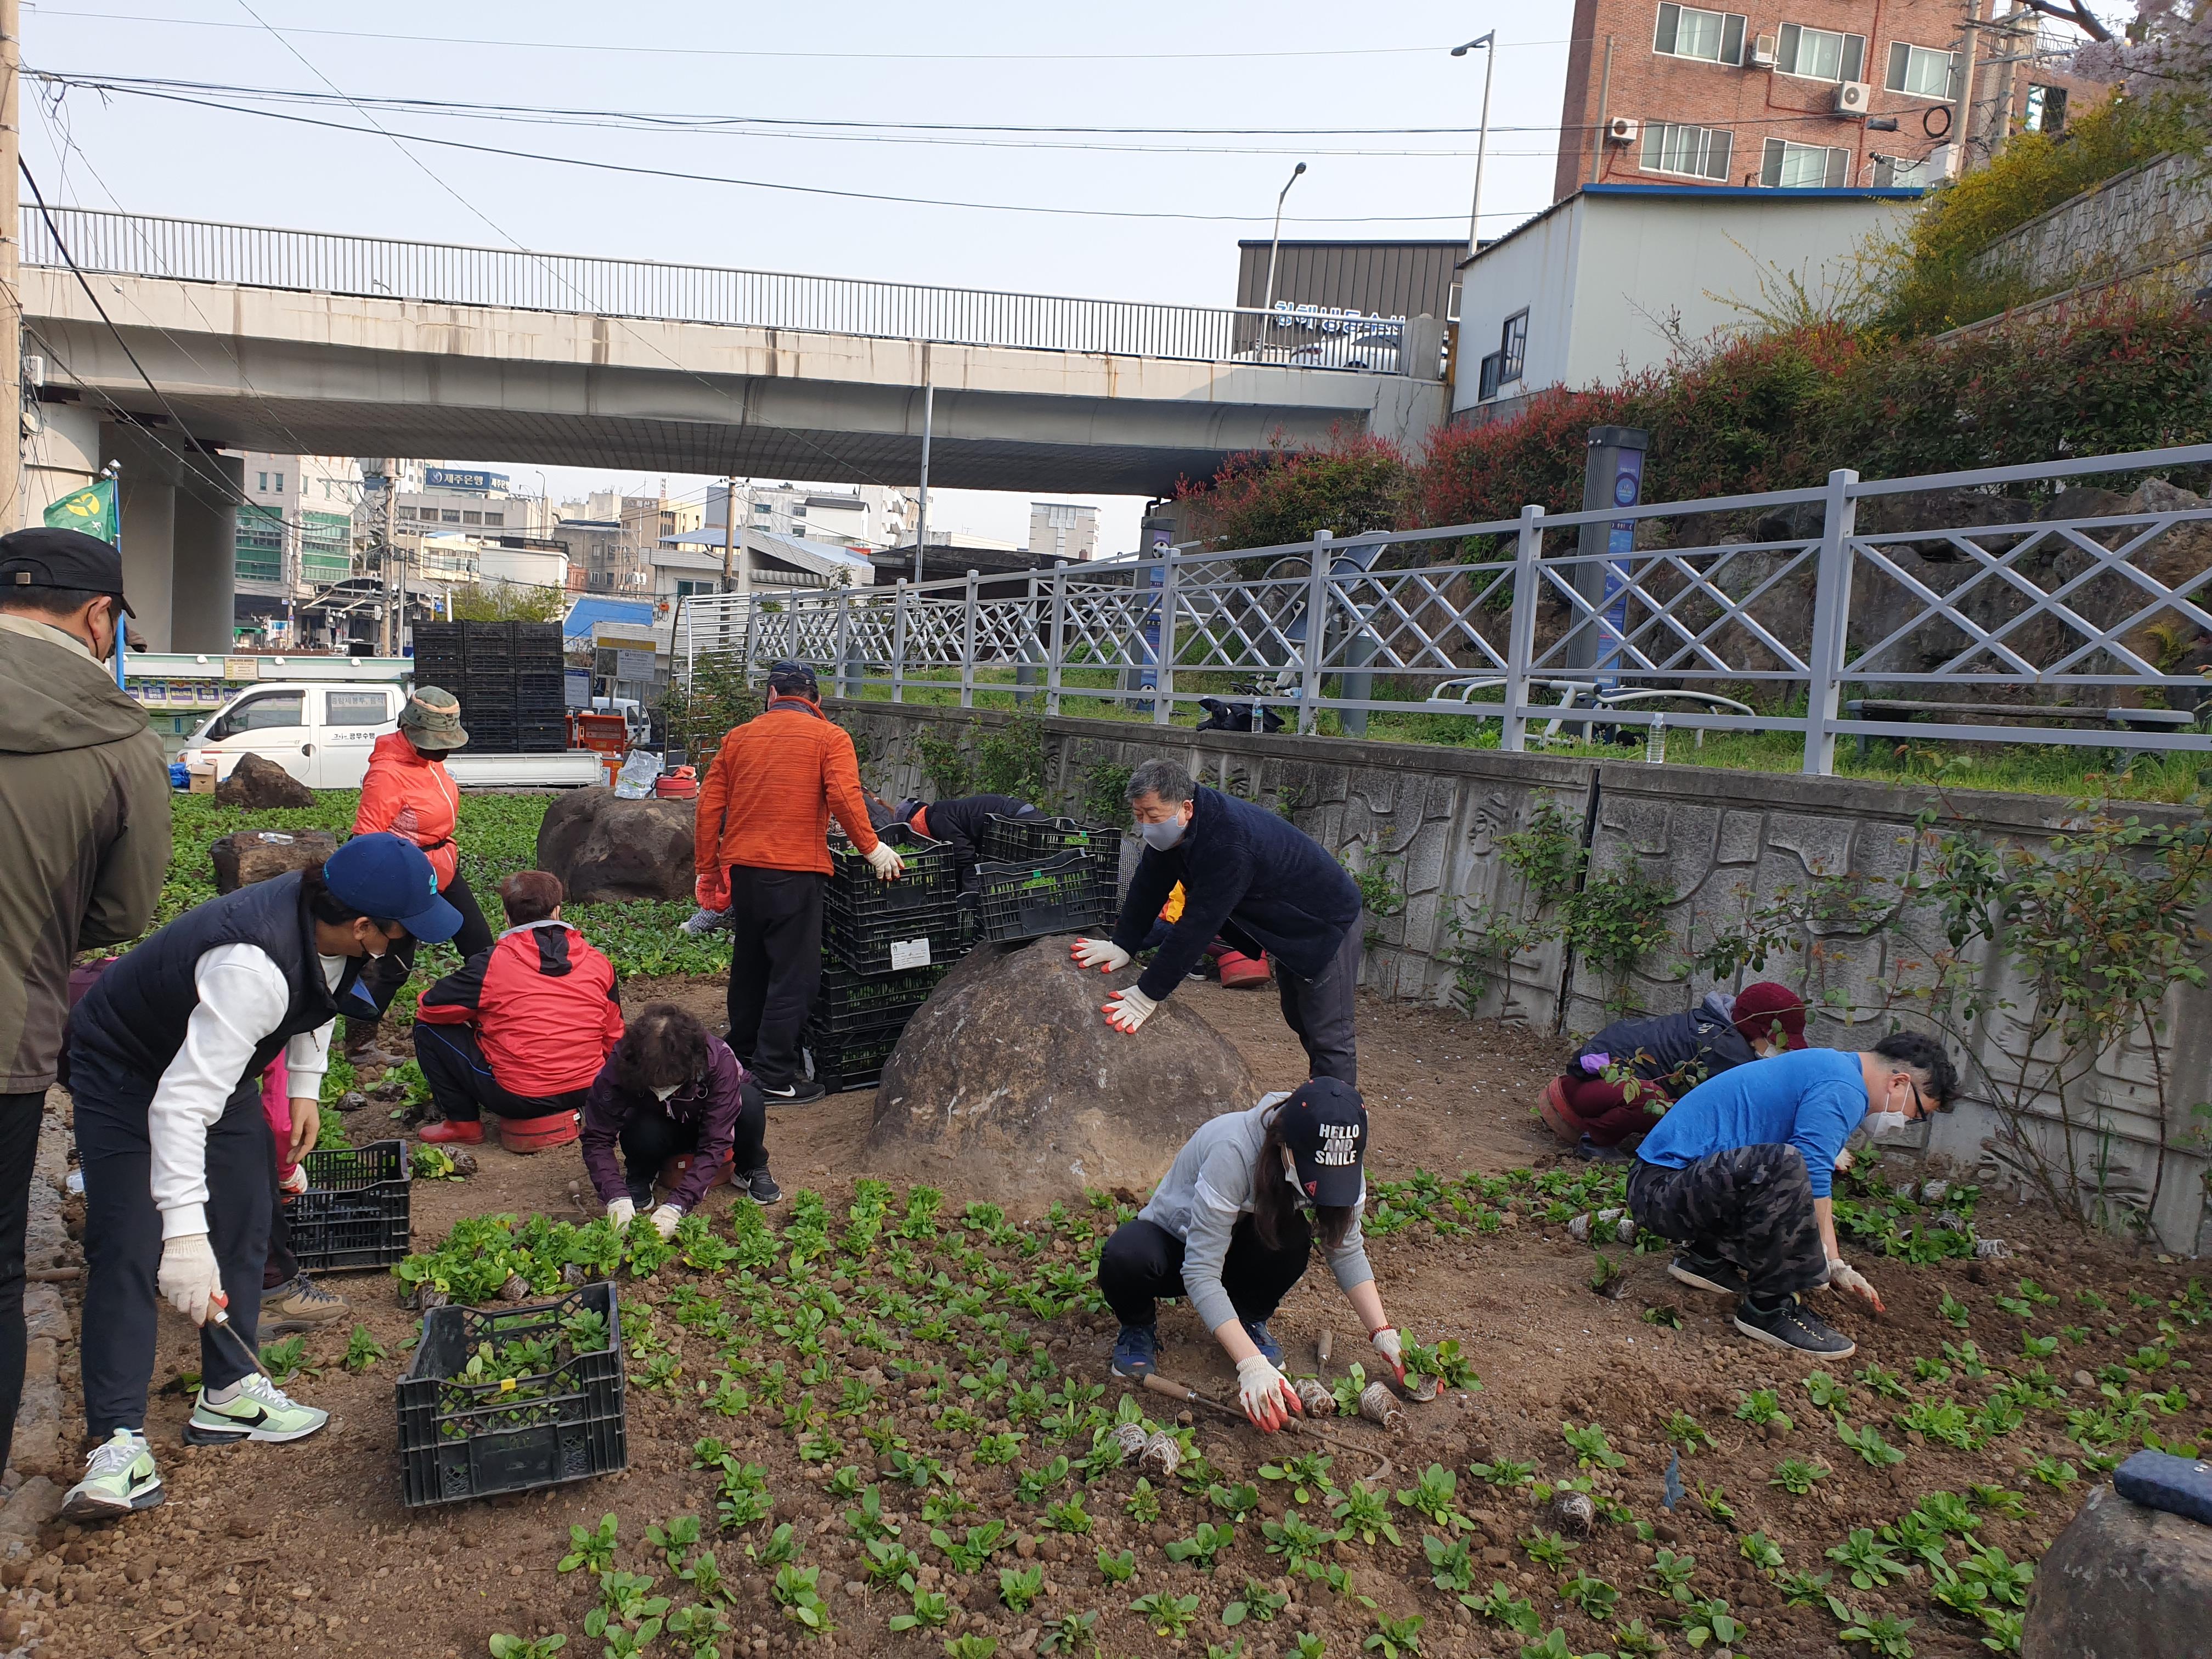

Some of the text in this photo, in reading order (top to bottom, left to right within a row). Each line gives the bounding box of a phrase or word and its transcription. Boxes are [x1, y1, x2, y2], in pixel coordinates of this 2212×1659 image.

[444, 473, 483, 486] 제주은행
[1319, 1123, 1359, 1139] HELLO
[1323, 1138, 1353, 1152] AND
[1314, 1150, 1357, 1166] SMILE
